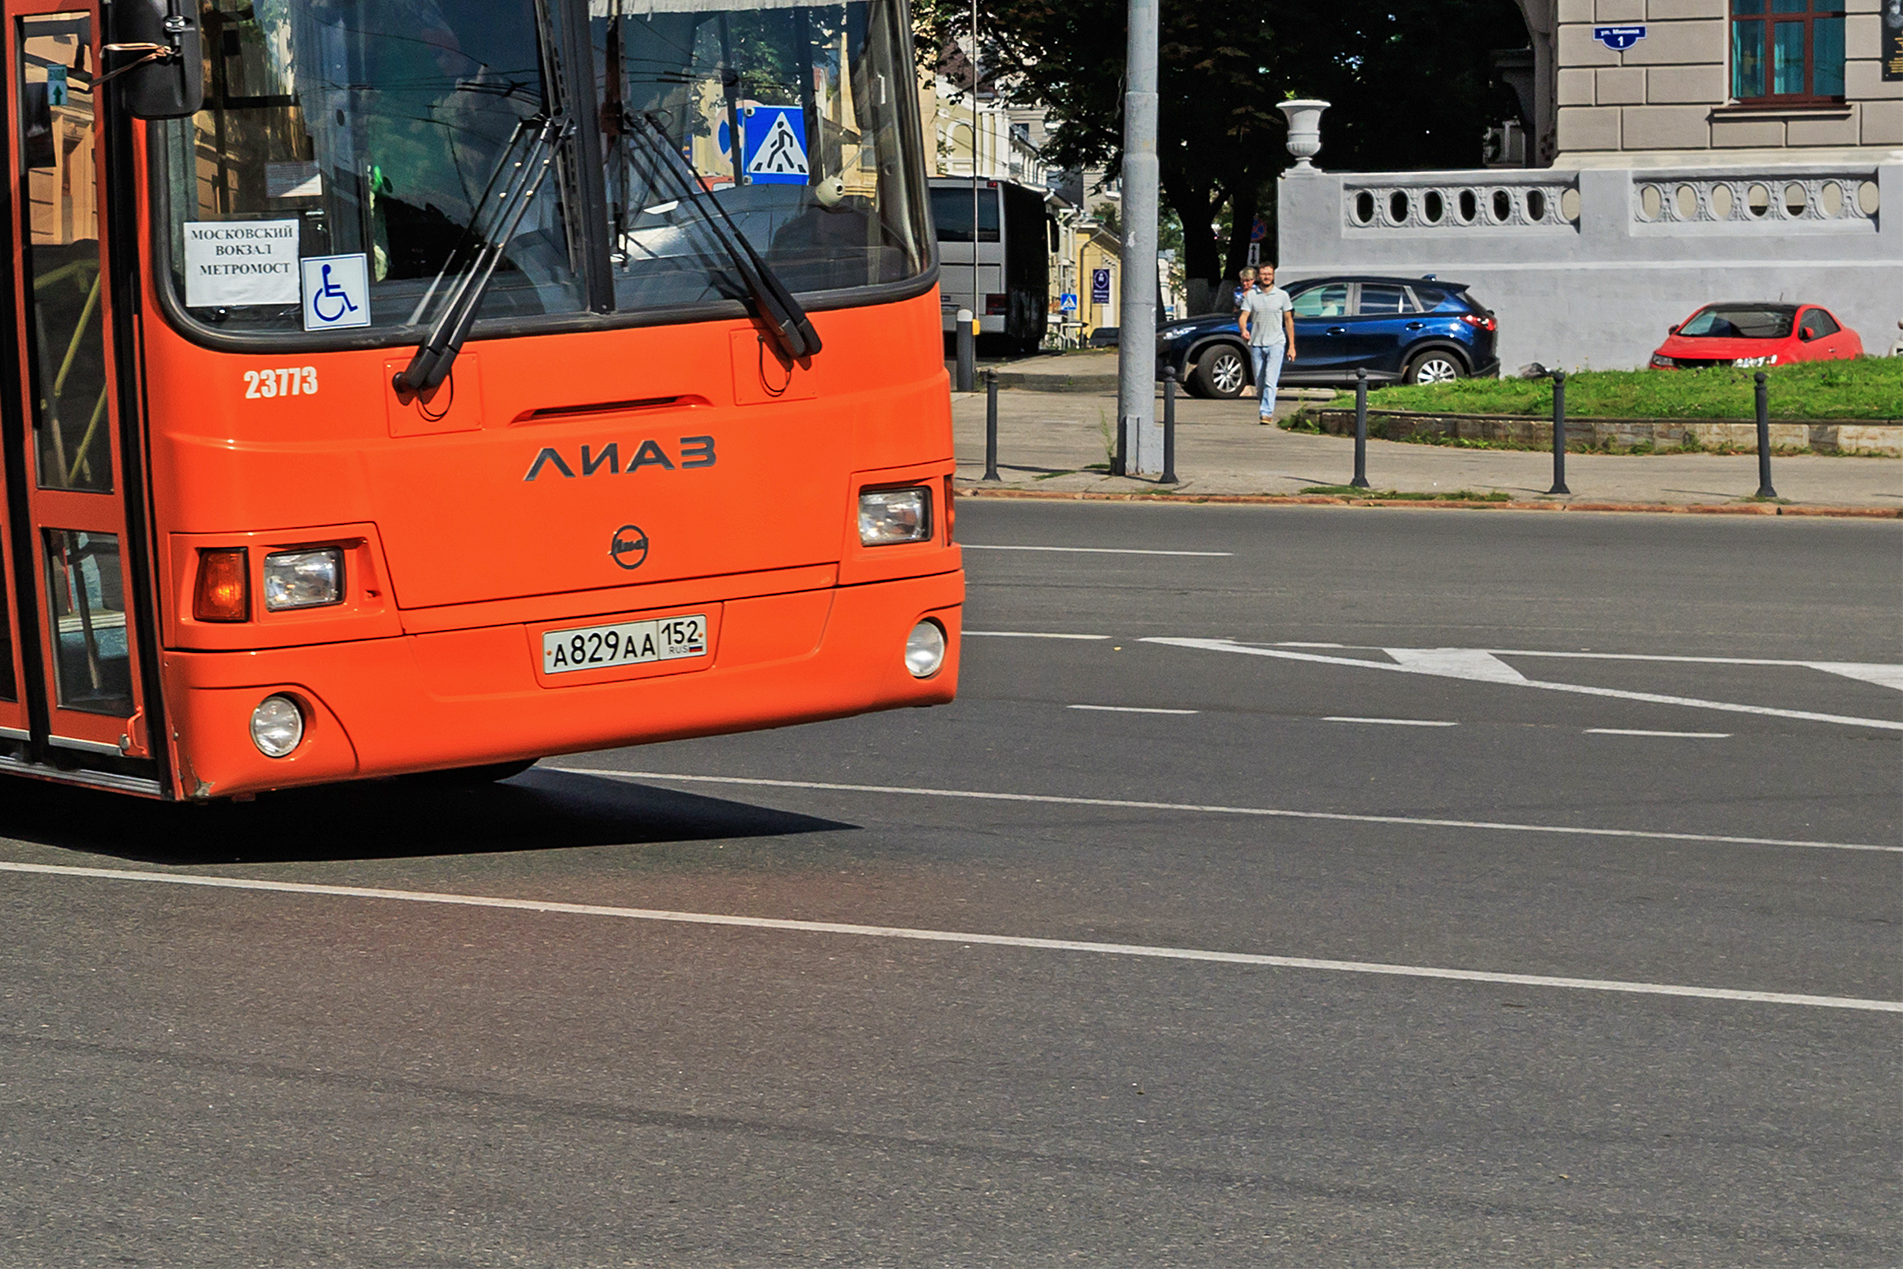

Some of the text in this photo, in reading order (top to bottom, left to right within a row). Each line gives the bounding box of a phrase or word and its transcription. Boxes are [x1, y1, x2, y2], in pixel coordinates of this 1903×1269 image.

[1617, 35, 1624, 46] 1
[190, 225, 293, 240] МОСКОВСКИЙ
[215, 244, 272, 257] ВОКЗАЛ
[199, 262, 291, 276] МЕТРОМОСТ
[243, 366, 319, 399] 23773
[523, 435, 717, 481] ЛИАЗ
[553, 620, 699, 667] А829АА 152
[669, 645, 688, 654] RUS
